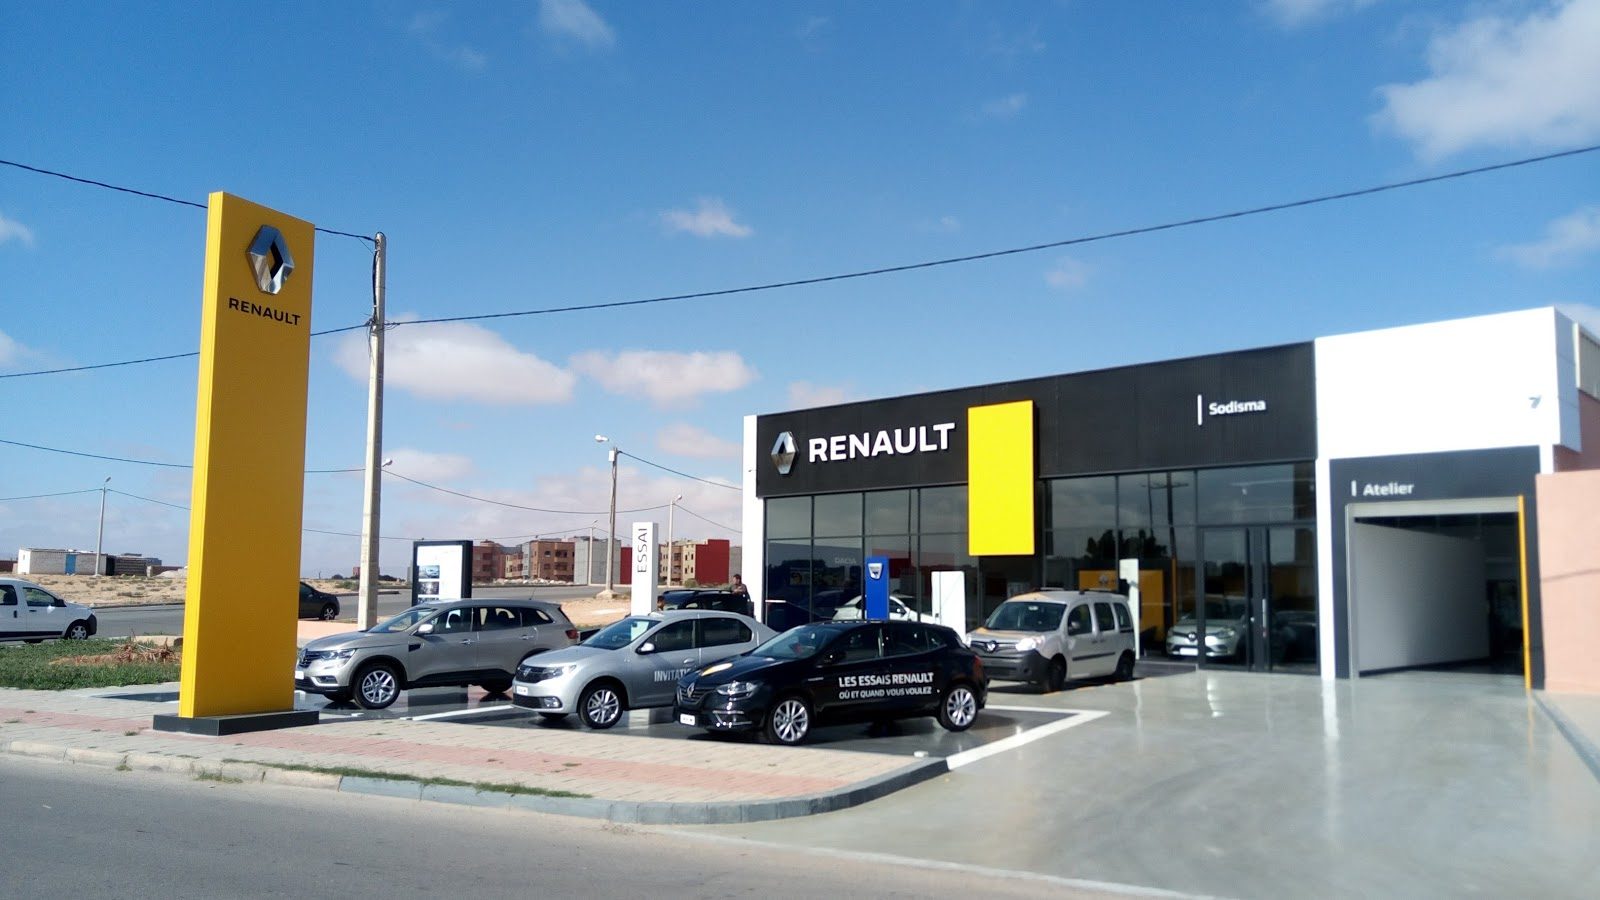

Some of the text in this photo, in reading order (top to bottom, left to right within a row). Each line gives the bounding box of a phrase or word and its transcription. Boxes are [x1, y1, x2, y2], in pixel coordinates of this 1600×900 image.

[228, 297, 301, 326] RENAULT
[1208, 400, 1267, 416] Sodisma
[808, 422, 956, 463] RENAULT
[1362, 481, 1415, 497] Atelier
[637, 528, 648, 573] ESSAI
[838, 672, 934, 688] LES ESSAIS RENAULT
[850, 690, 860, 699] ET
[860, 688, 886, 698] QUAND
[886, 687, 906, 697] VOUS
[905, 686, 933, 695] VOULEZ
